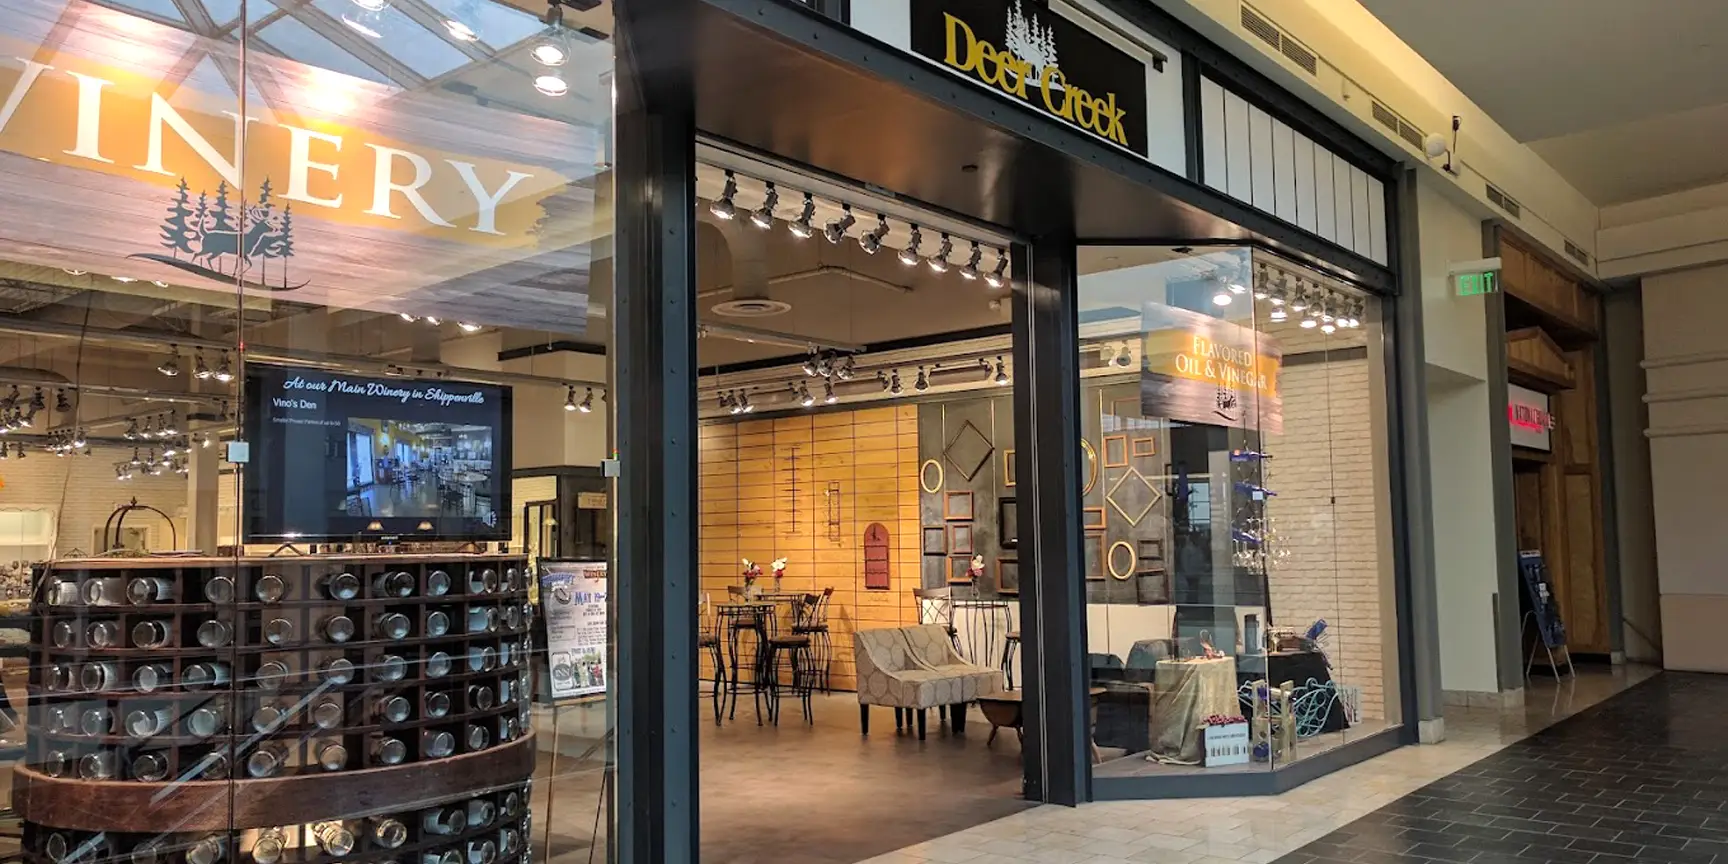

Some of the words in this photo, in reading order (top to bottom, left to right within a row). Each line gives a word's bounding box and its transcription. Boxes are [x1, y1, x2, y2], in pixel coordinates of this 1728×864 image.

[943, 11, 1031, 100] Deer
[1040, 64, 1128, 146] Creek
[0, 56, 534, 237] INERY
[1459, 272, 1494, 296] EXIT
[1192, 335, 1252, 368] FLAVORED
[1175, 353, 1202, 376] OIL
[1204, 359, 1217, 379] &
[1218, 362, 1268, 390] VINEGAR
[272, 397, 298, 409] Vino's
[300, 399, 317, 410] Den
[282, 376, 304, 389] At
[306, 381, 327, 391] our
[328, 380, 366, 395] Main
[367, 383, 410, 403] Winery
[412, 389, 423, 399] in
[424, 387, 484, 406] Shippenville
